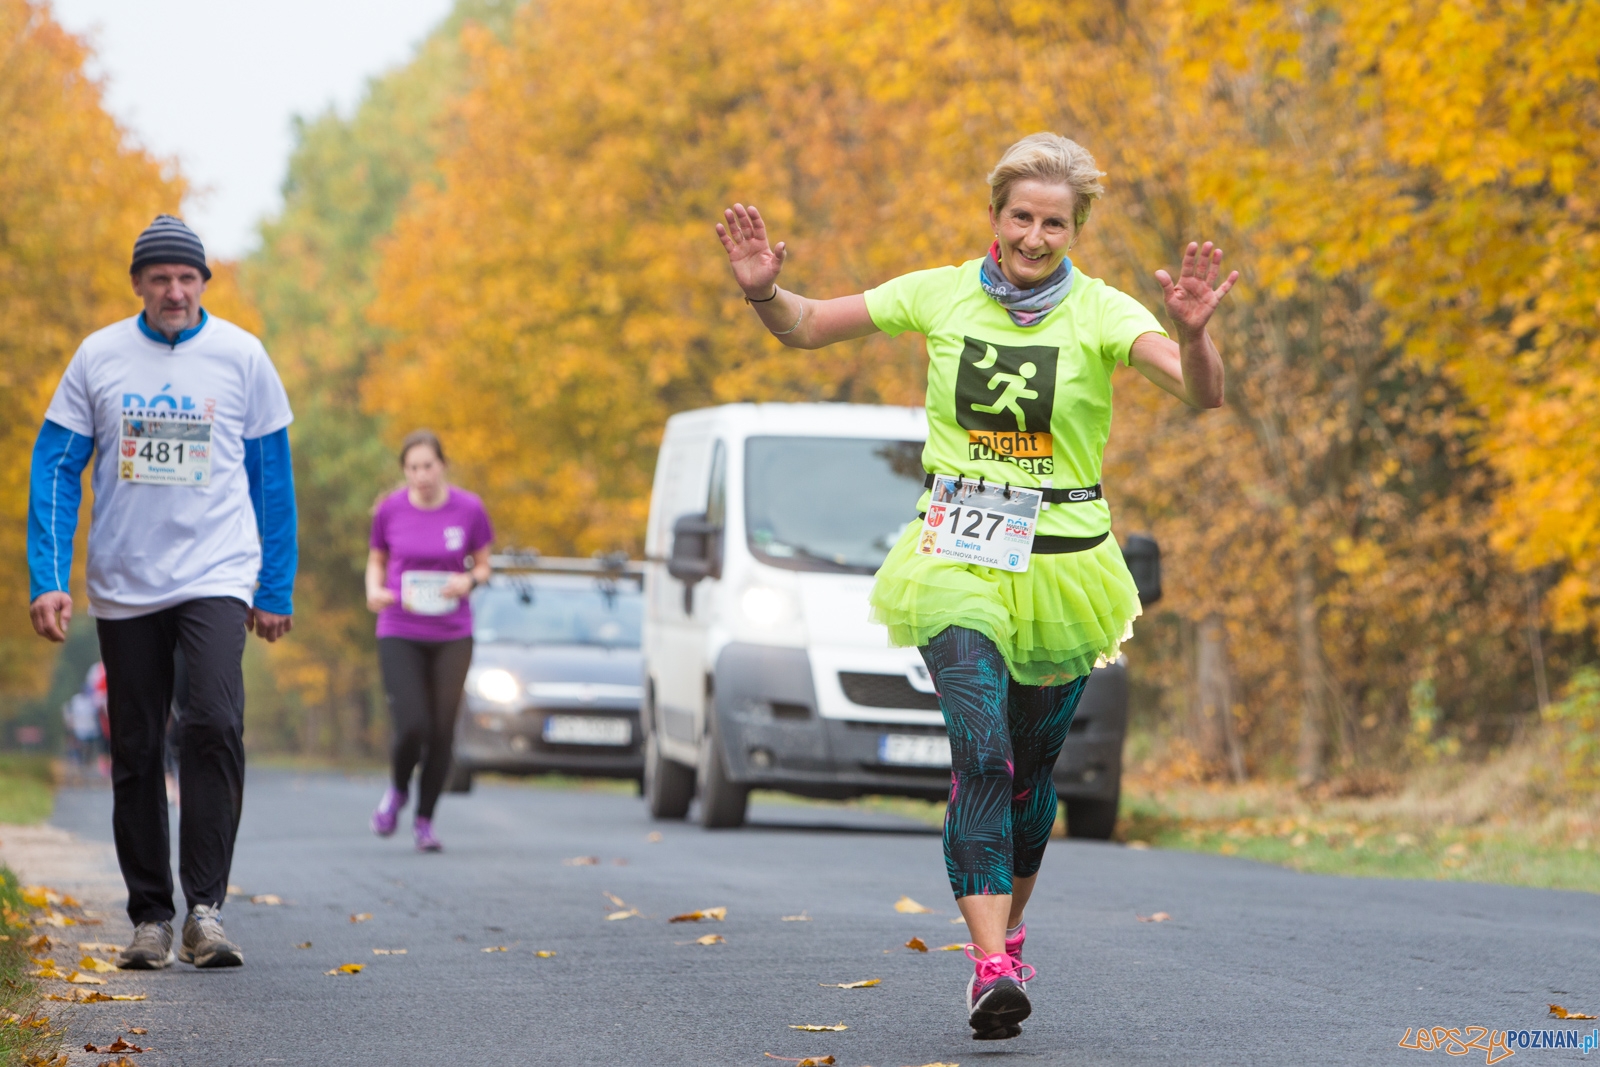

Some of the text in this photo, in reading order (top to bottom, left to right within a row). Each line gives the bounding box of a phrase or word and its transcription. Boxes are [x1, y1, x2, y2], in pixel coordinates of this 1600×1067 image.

[138, 441, 184, 465] 481
[978, 432, 1038, 455] night
[949, 507, 1004, 541] 127
[942, 548, 998, 565] POLINOVA POLSKA
[955, 539, 981, 552] Elwira
